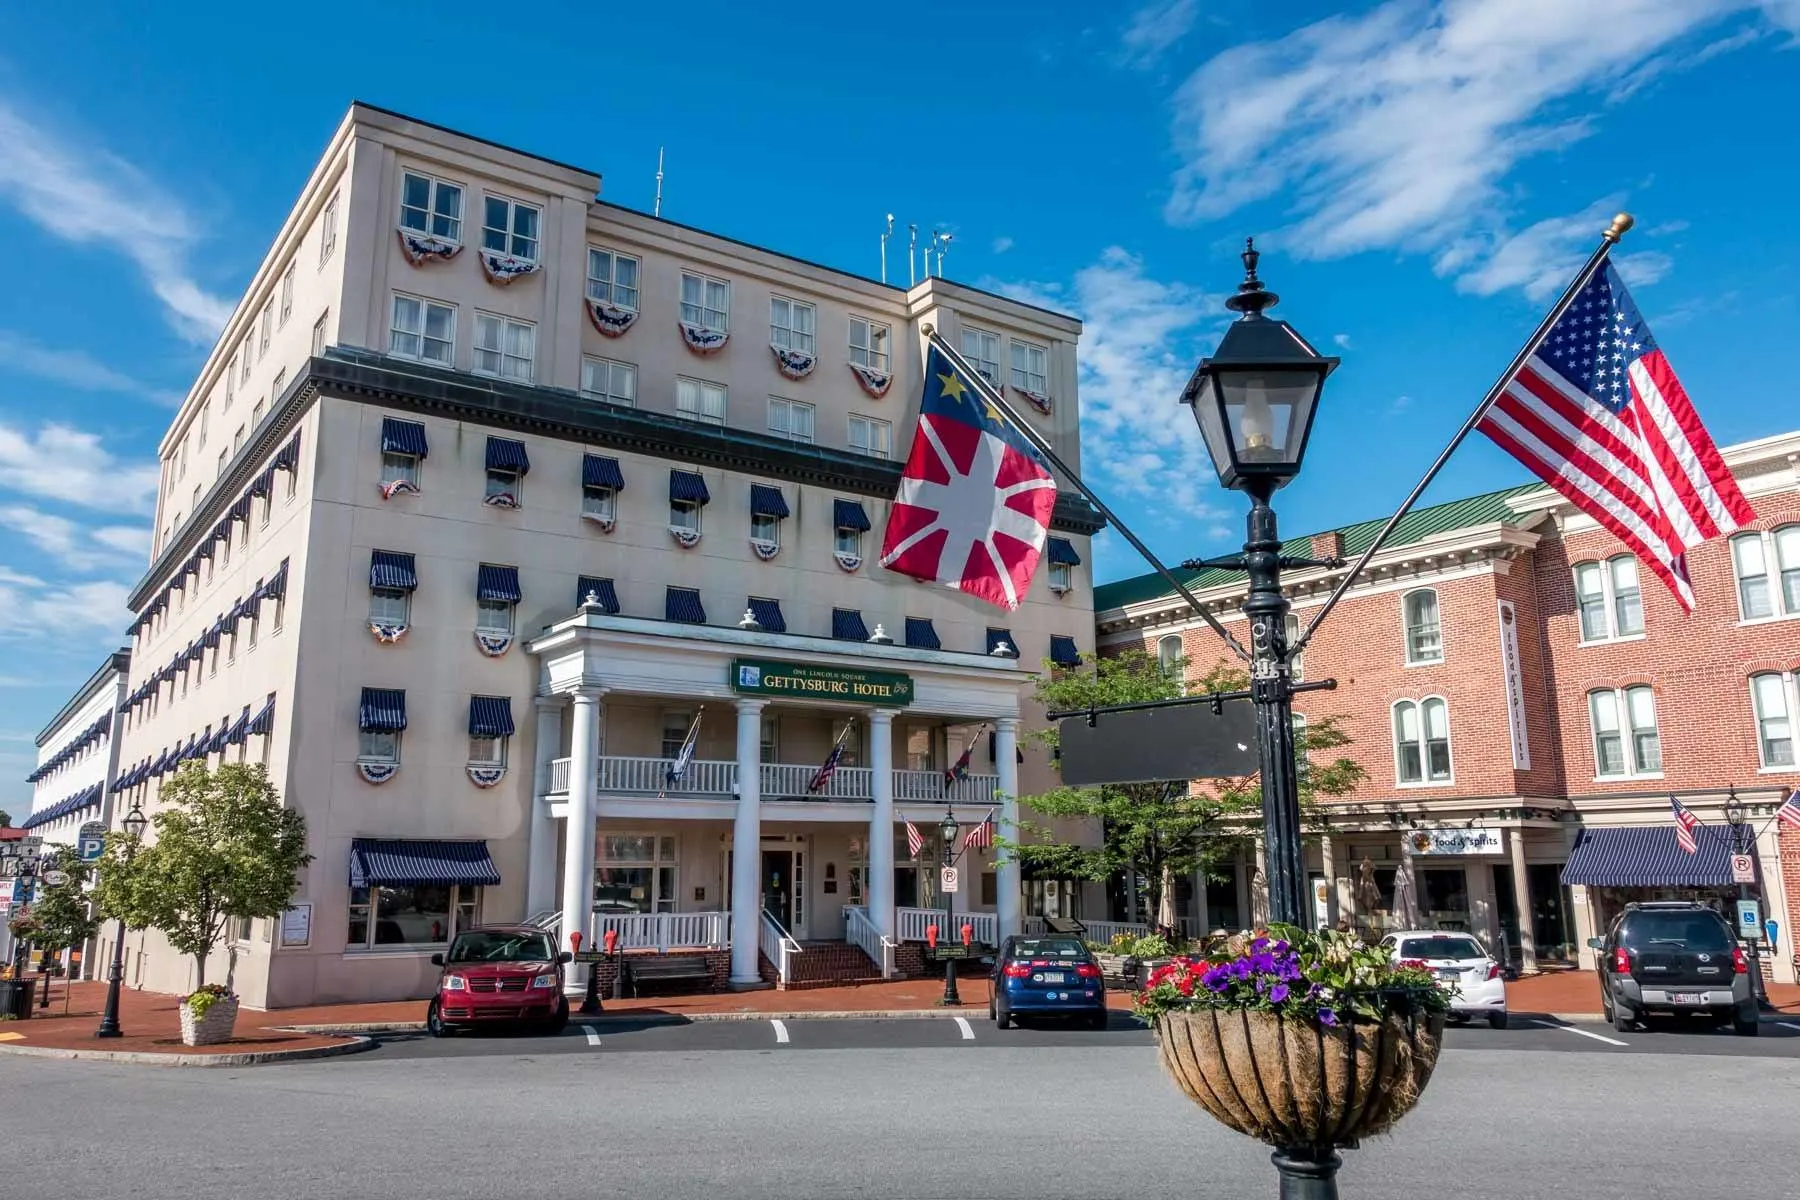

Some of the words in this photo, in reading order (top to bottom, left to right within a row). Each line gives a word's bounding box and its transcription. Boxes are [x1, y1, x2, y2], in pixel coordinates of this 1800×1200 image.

[793, 668, 807, 676] ONE
[809, 670, 839, 679] LINCOLN
[841, 673, 866, 681] SQUARE
[763, 675, 849, 694] GETTYSBURG
[853, 682, 892, 697] HOTEL
[1507, 632, 1515, 671] food
[1512, 688, 1524, 761] spirits
[83, 840, 101, 858] P
[1435, 837, 1456, 847] food
[1470, 837, 1498, 848] spirits
